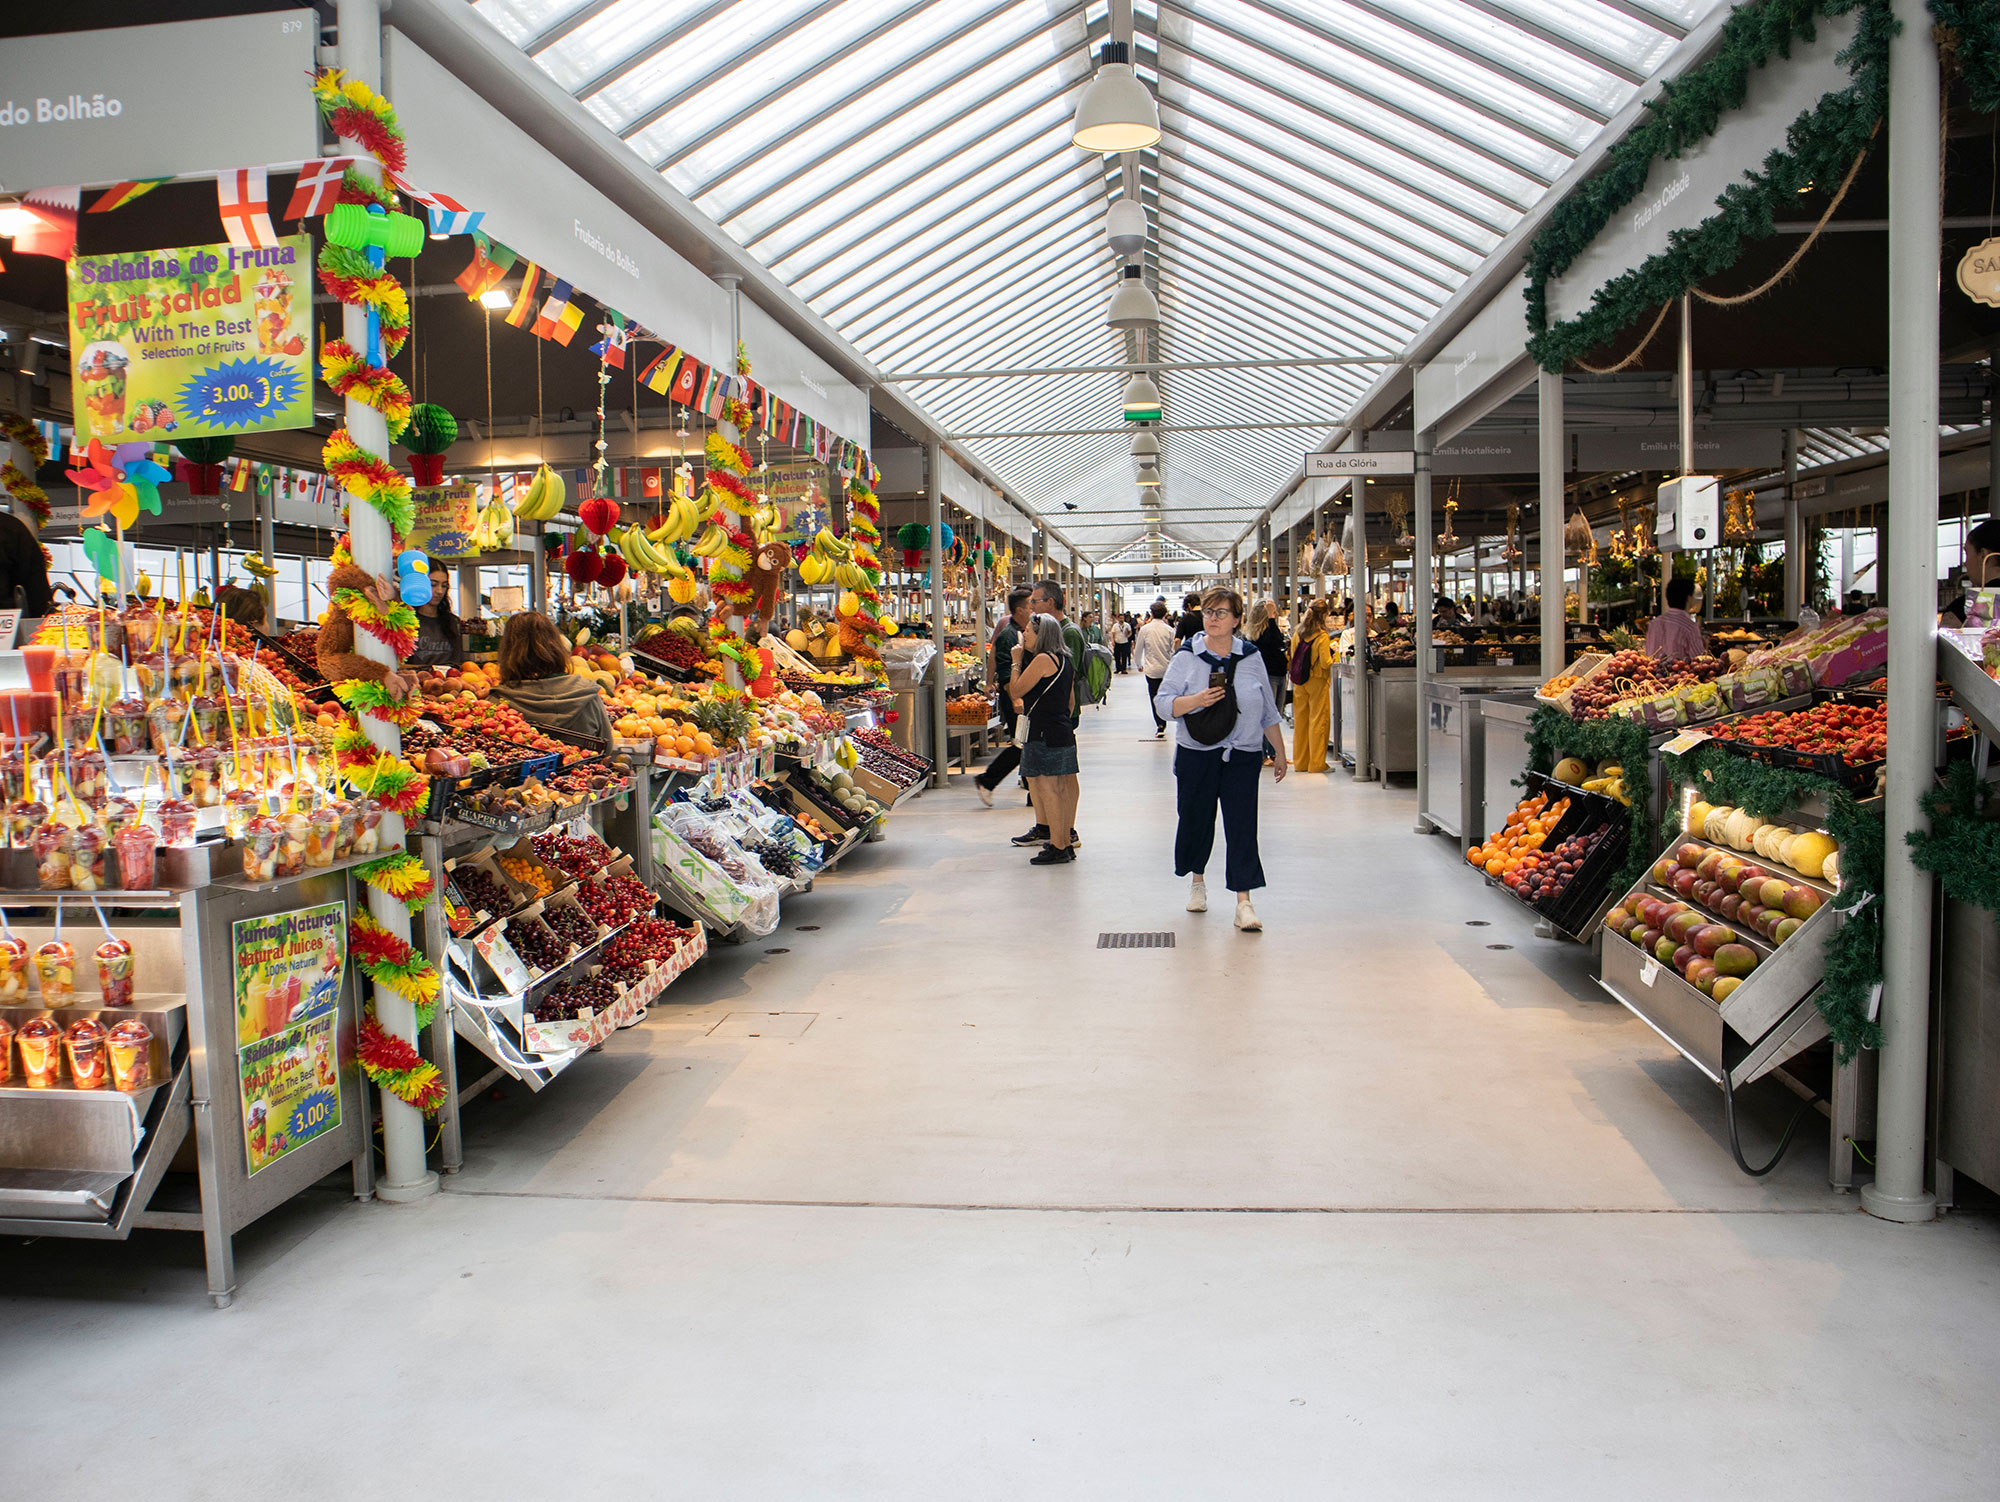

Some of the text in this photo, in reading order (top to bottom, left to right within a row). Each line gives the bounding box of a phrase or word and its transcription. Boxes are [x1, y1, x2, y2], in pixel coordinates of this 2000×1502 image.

[282, 20, 302, 33] B79
[0, 94, 122, 126] do Bolhão
[1634, 171, 1690, 233] Fruta na Cidade
[574, 218, 640, 279] Frutaria do Bolhão
[81, 246, 296, 285] Saladas de Fruta
[1974, 255, 2000, 274] SA
[75, 275, 242, 329] Fruit salad
[132, 318, 252, 344] With The Best
[141, 340, 246, 360] Selection Of Fruits
[1316, 458, 1377, 468] Rua da Glória
[1461, 446, 1512, 455] Hortaliceira
[444, 490, 470, 499] Fruta
[237, 908, 341, 945] Sumos Naturais
[237, 937, 323, 968] Natural Juices
[265, 954, 318, 977] 100% Natural
[245, 1018, 331, 1065] Saladas de Fruta
[243, 1064, 275, 1097] Fruit
[267, 1068, 315, 1098] With The Best
